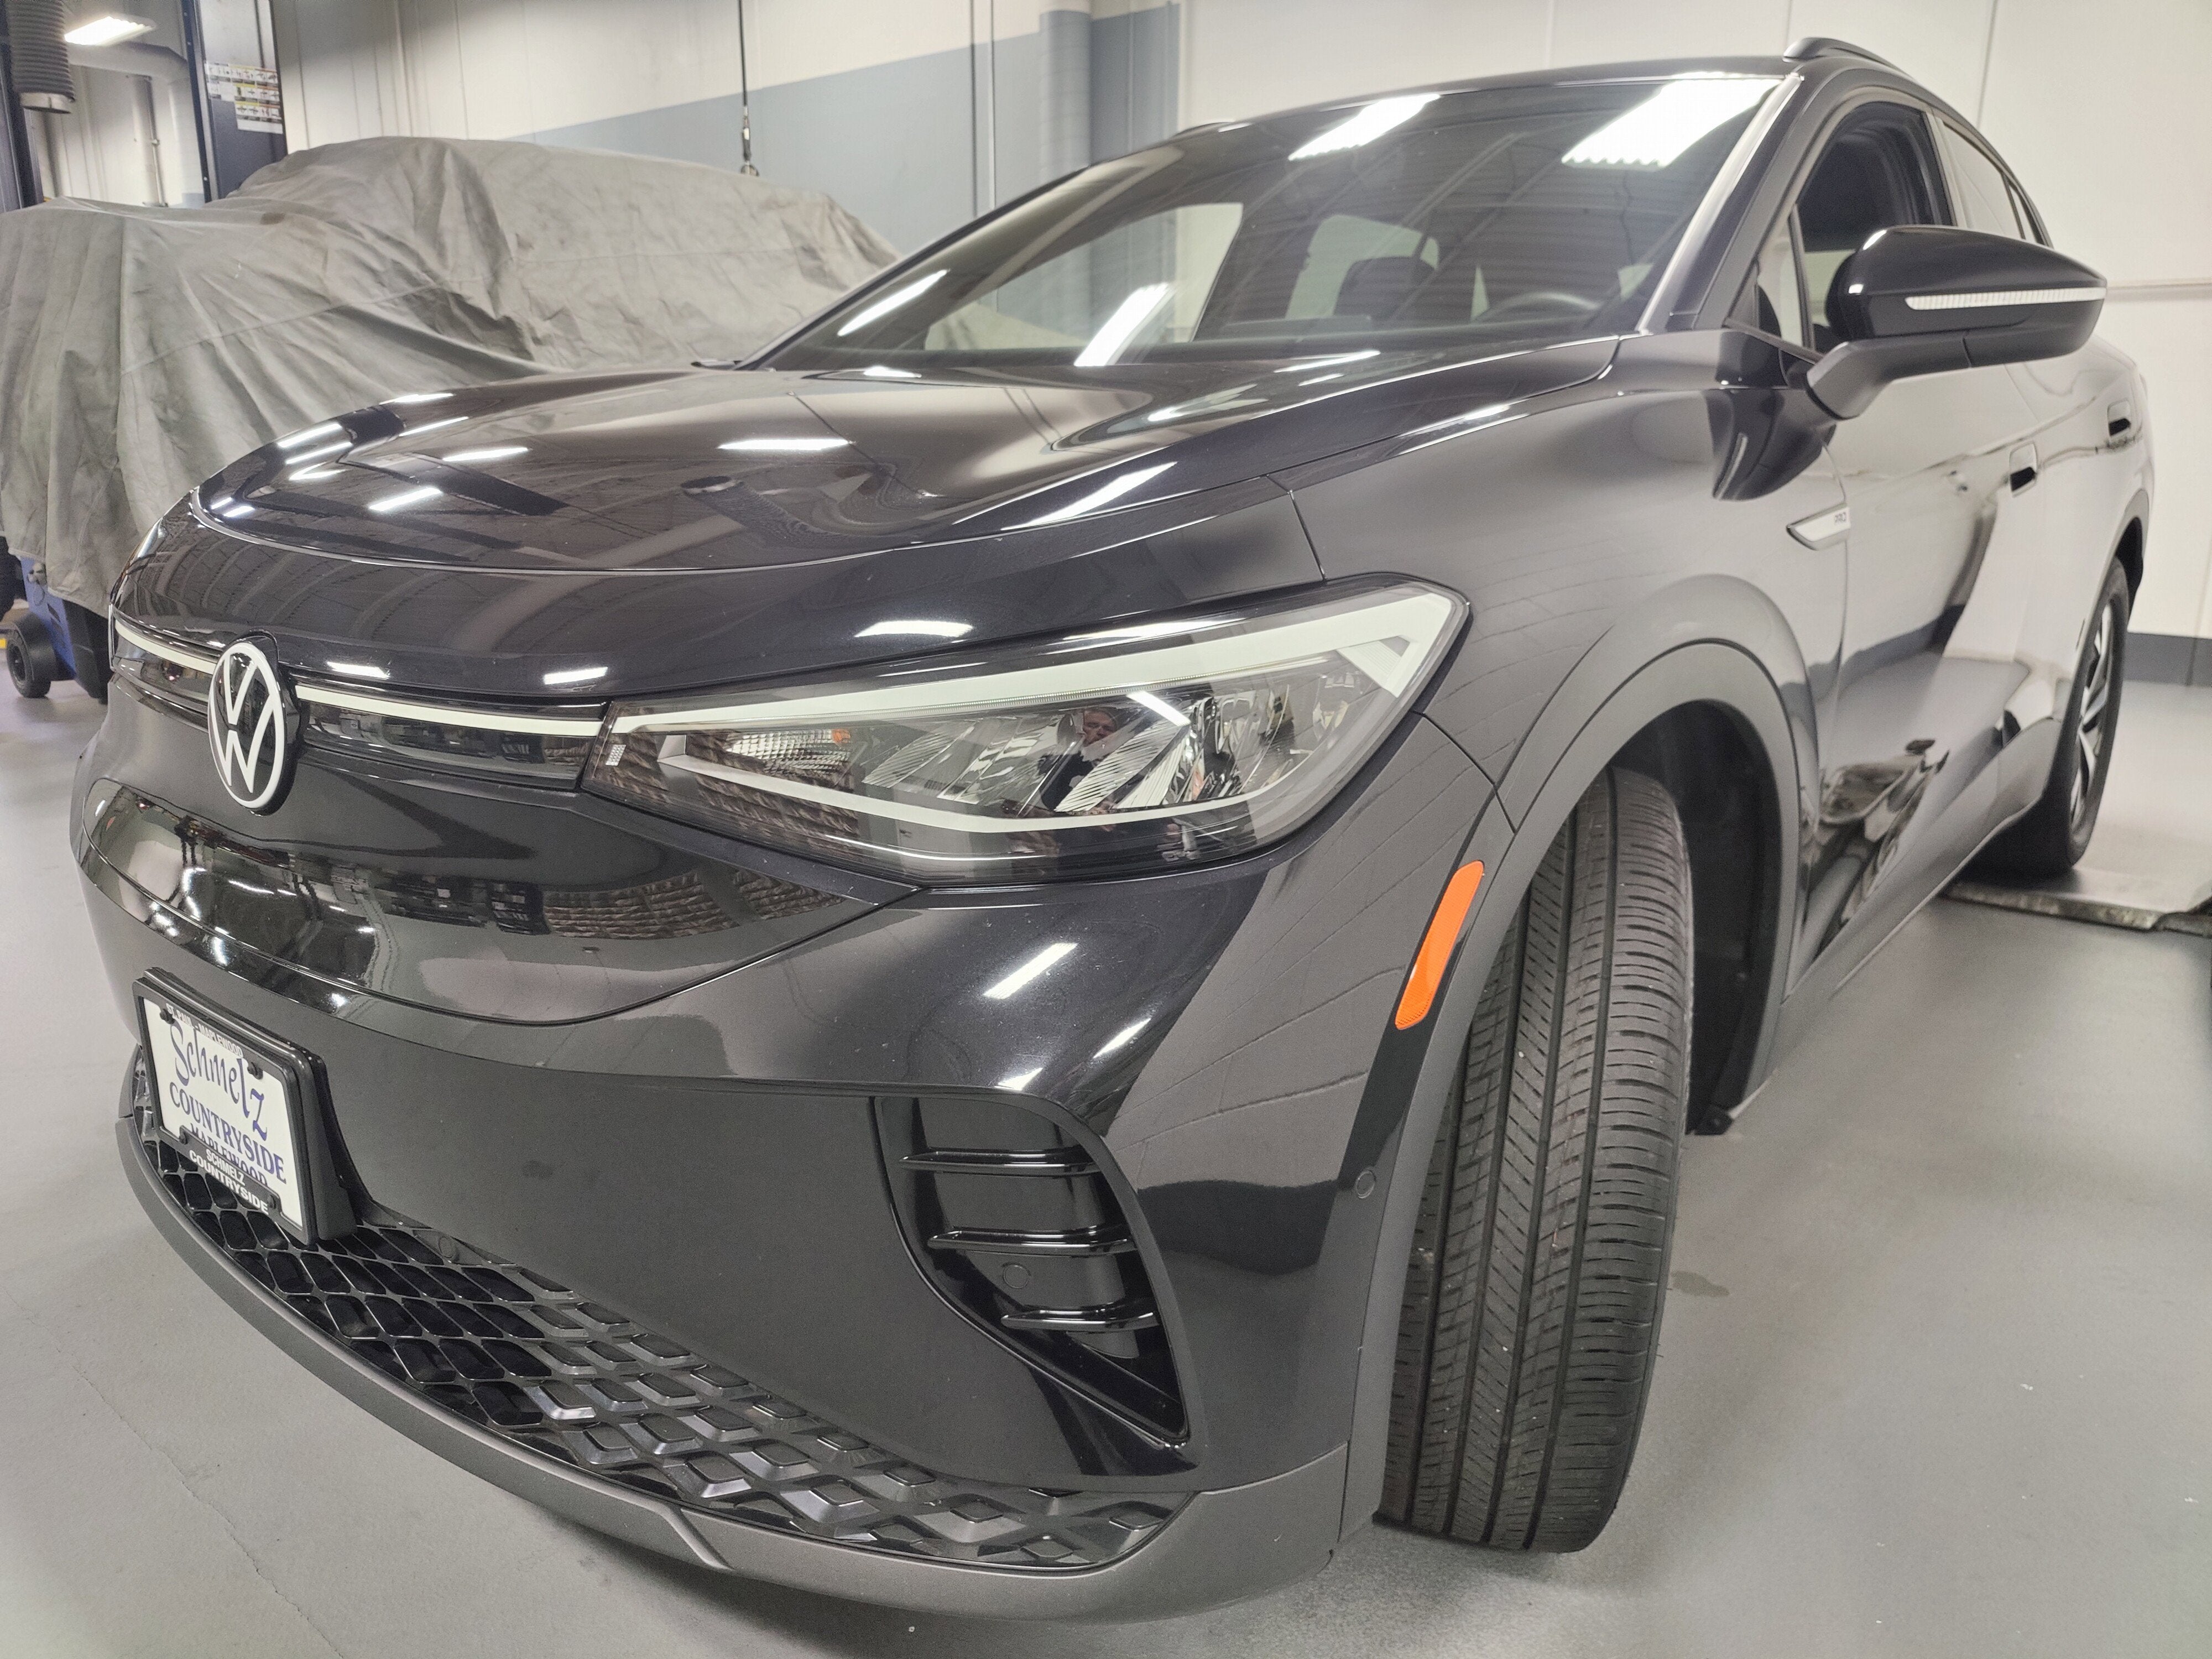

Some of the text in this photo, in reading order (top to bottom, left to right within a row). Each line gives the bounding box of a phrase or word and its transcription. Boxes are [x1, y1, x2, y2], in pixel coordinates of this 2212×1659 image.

[176, 1010, 194, 1028] PAUL
[198, 1023, 244, 1058] MAPLEWOOD
[169, 1082, 286, 1185] COUNTRYSIDE
[189, 1149, 269, 1215] COUNTRYSIDE
[205, 1148, 246, 1187] SCHMELZ
